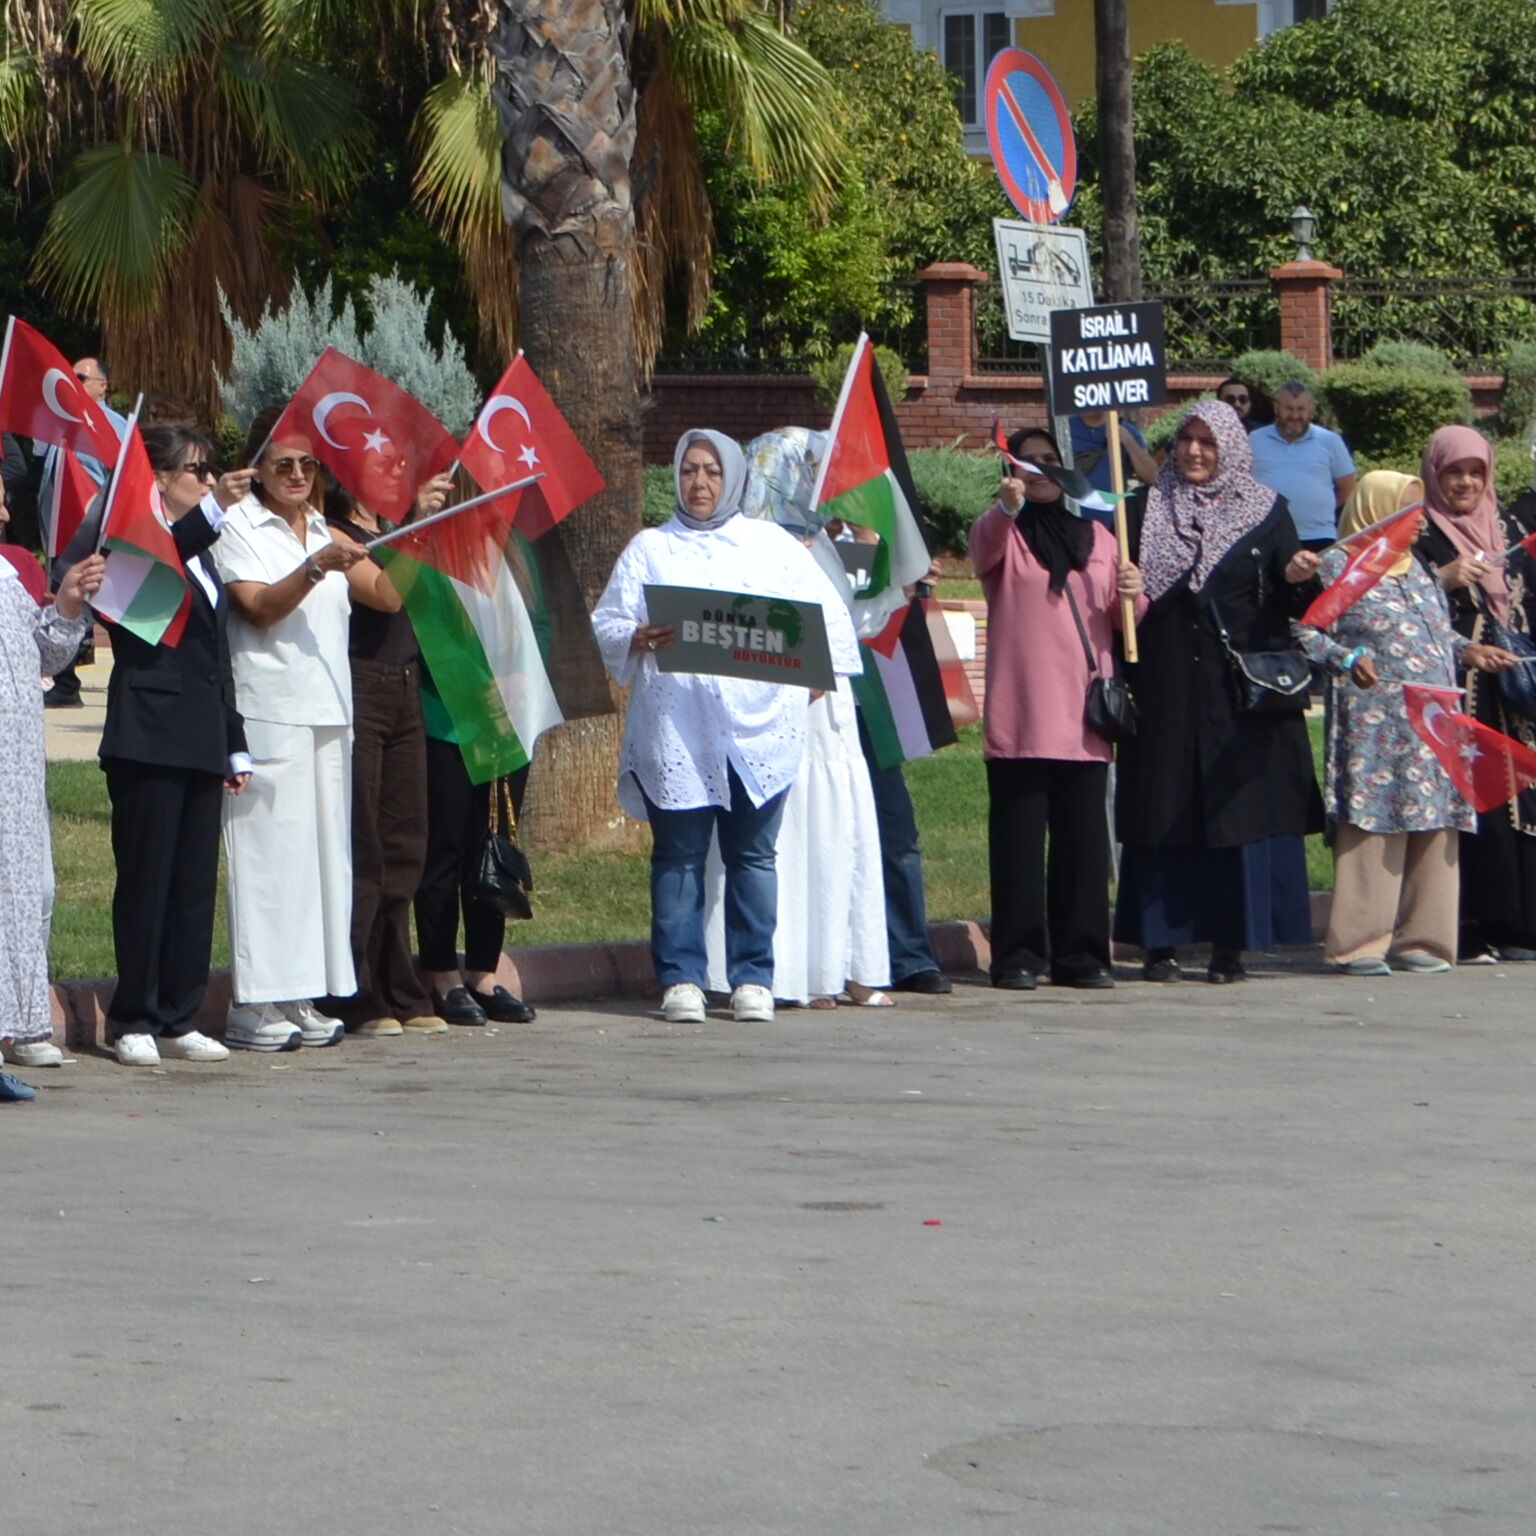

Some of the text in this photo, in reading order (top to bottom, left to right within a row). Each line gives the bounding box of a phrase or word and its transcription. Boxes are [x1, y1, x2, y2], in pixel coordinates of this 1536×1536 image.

[1022, 291, 1035, 305] 15
[1080, 310, 1139, 339] İSRAİL !
[1061, 340, 1155, 374] KATLİAMA
[1074, 378, 1149, 408] SON VER
[682, 620, 784, 654] BEŞTEN
